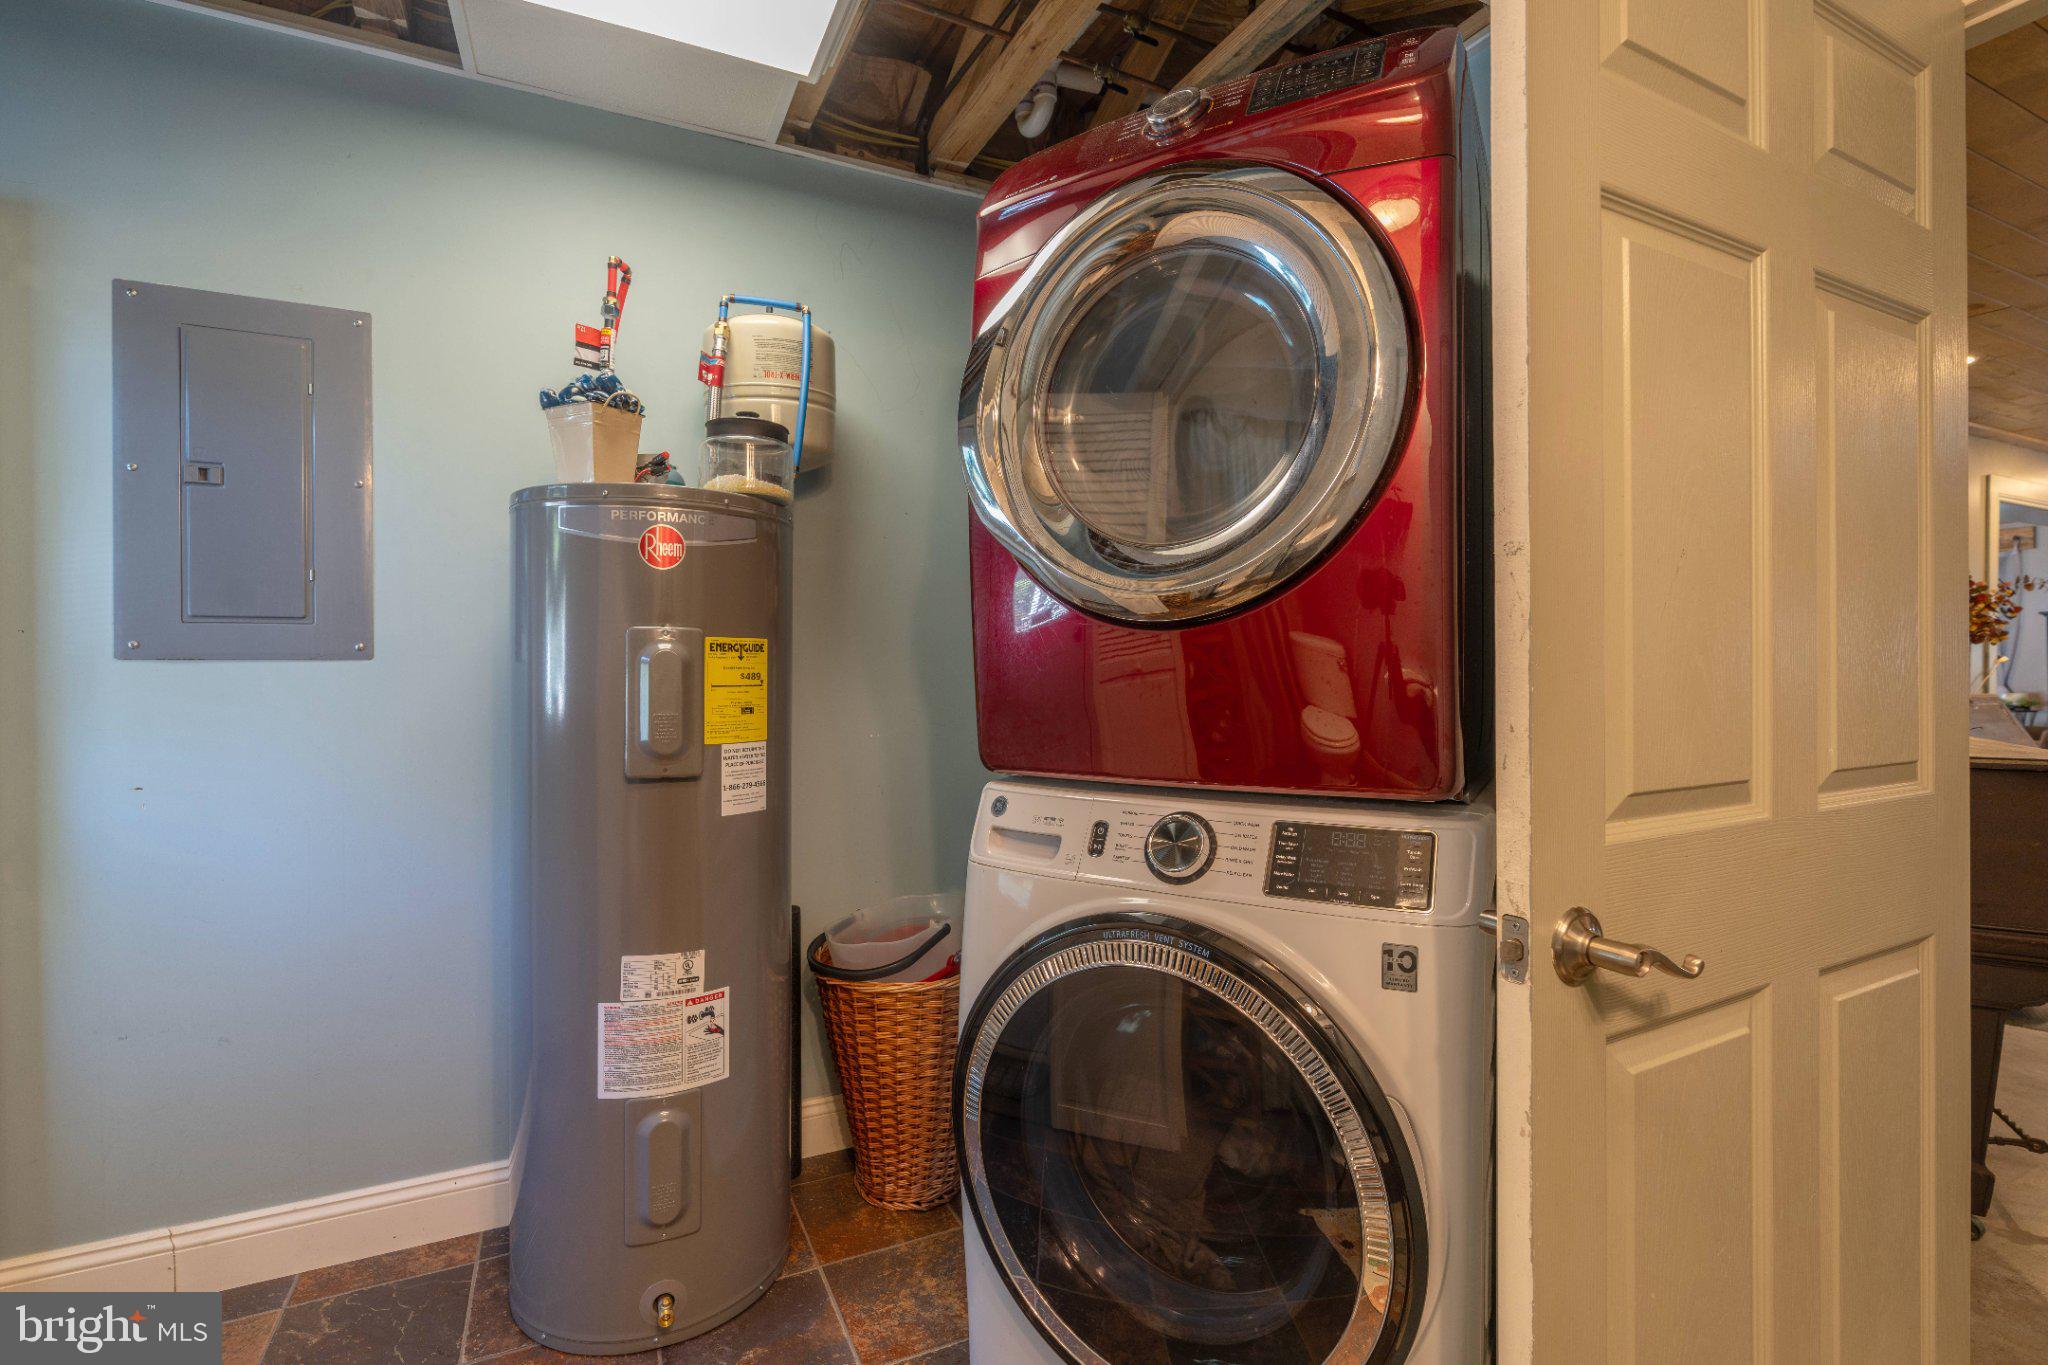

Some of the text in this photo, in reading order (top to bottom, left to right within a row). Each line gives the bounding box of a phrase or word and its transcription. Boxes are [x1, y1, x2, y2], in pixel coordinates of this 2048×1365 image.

[644, 526, 683, 561] Rheem
[709, 642, 765, 654] ENERGYGUIDE
[740, 672, 762, 681] $489
[1103, 930, 1211, 958] ULTRAFRESH VENT SYSTEM
[694, 992, 724, 1004] DANGER
